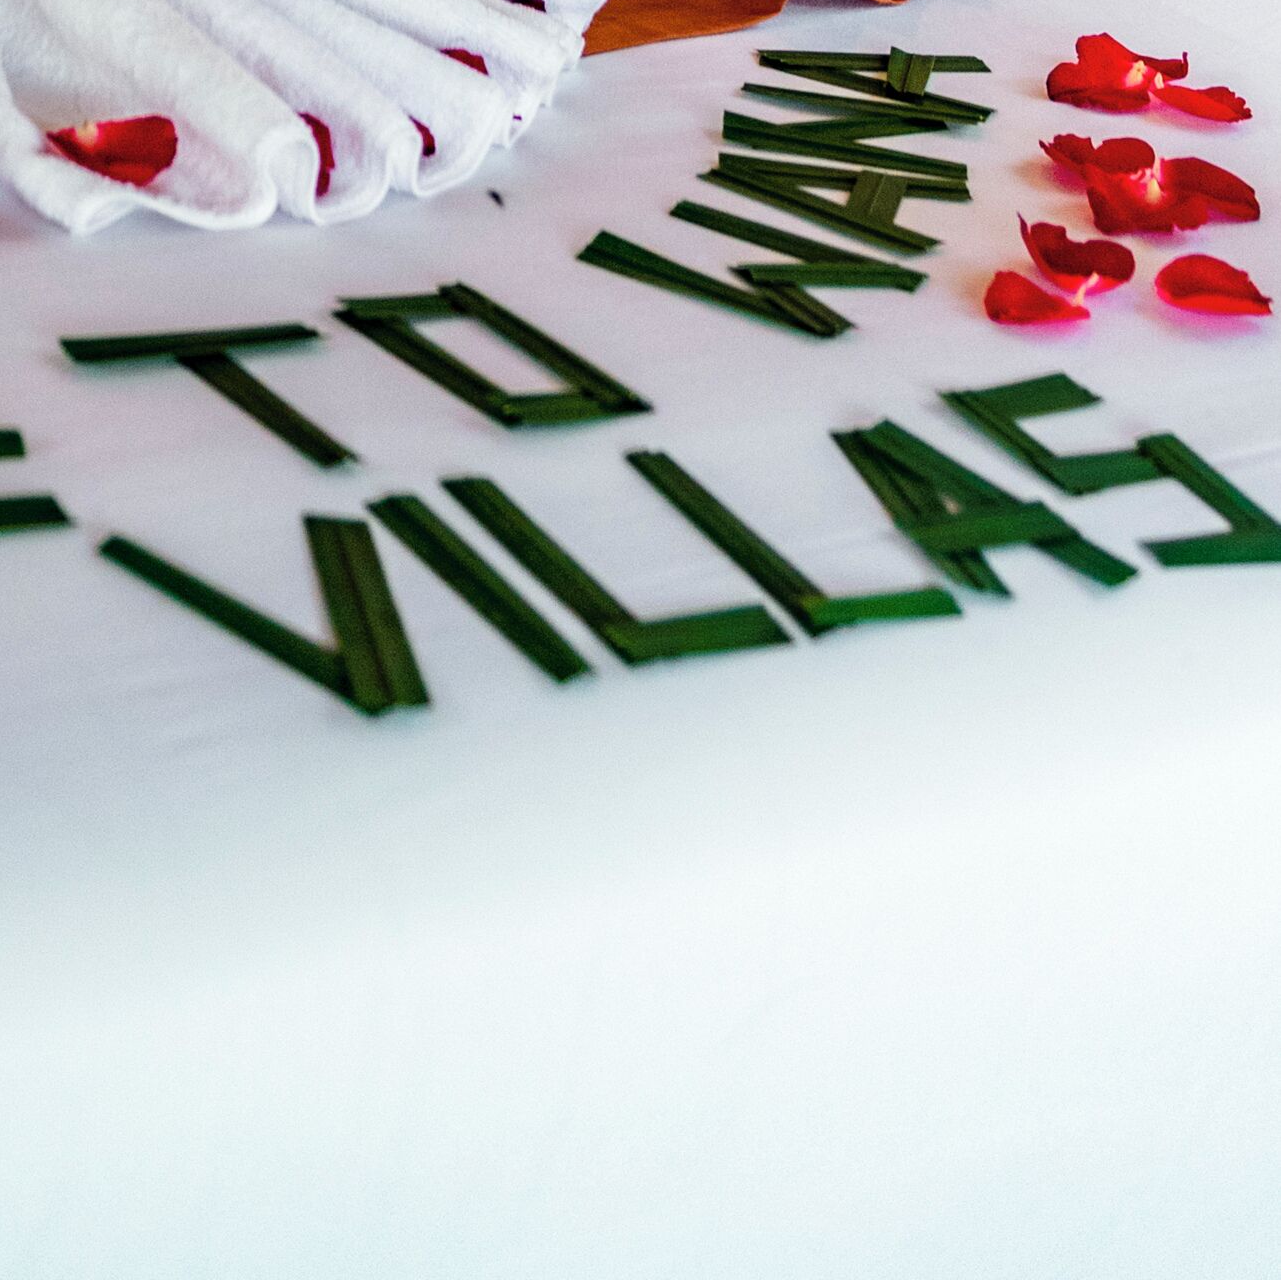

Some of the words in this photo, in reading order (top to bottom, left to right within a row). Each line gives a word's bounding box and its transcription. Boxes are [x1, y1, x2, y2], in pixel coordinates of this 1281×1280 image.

[60, 282, 653, 468] TO
[576, 46, 997, 339] WANA
[99, 372, 1281, 716] VILLAS
